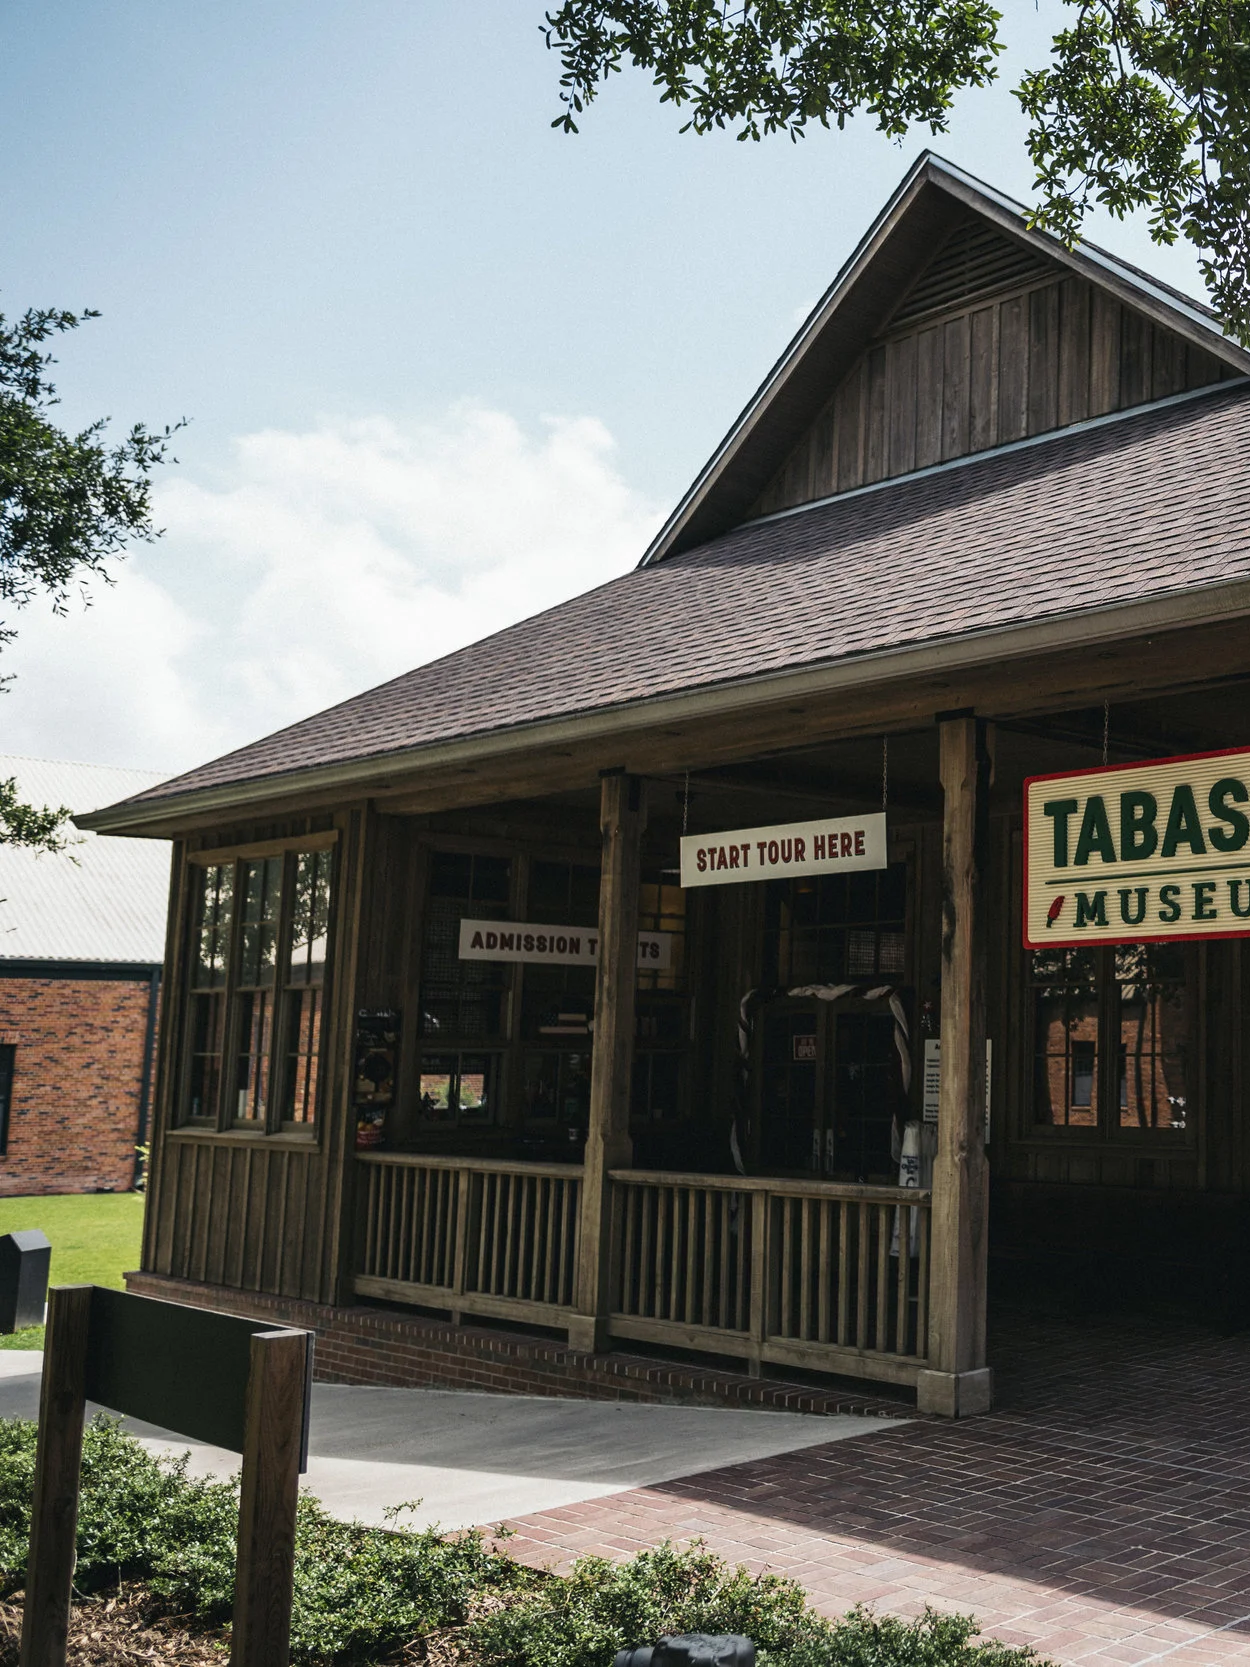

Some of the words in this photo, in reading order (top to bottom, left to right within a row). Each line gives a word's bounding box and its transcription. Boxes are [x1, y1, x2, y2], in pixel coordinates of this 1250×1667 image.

[697, 843, 750, 872] START
[757, 837, 806, 867] TOUR
[813, 830, 866, 860] HERE
[470, 931, 581, 955] ADMISSION
